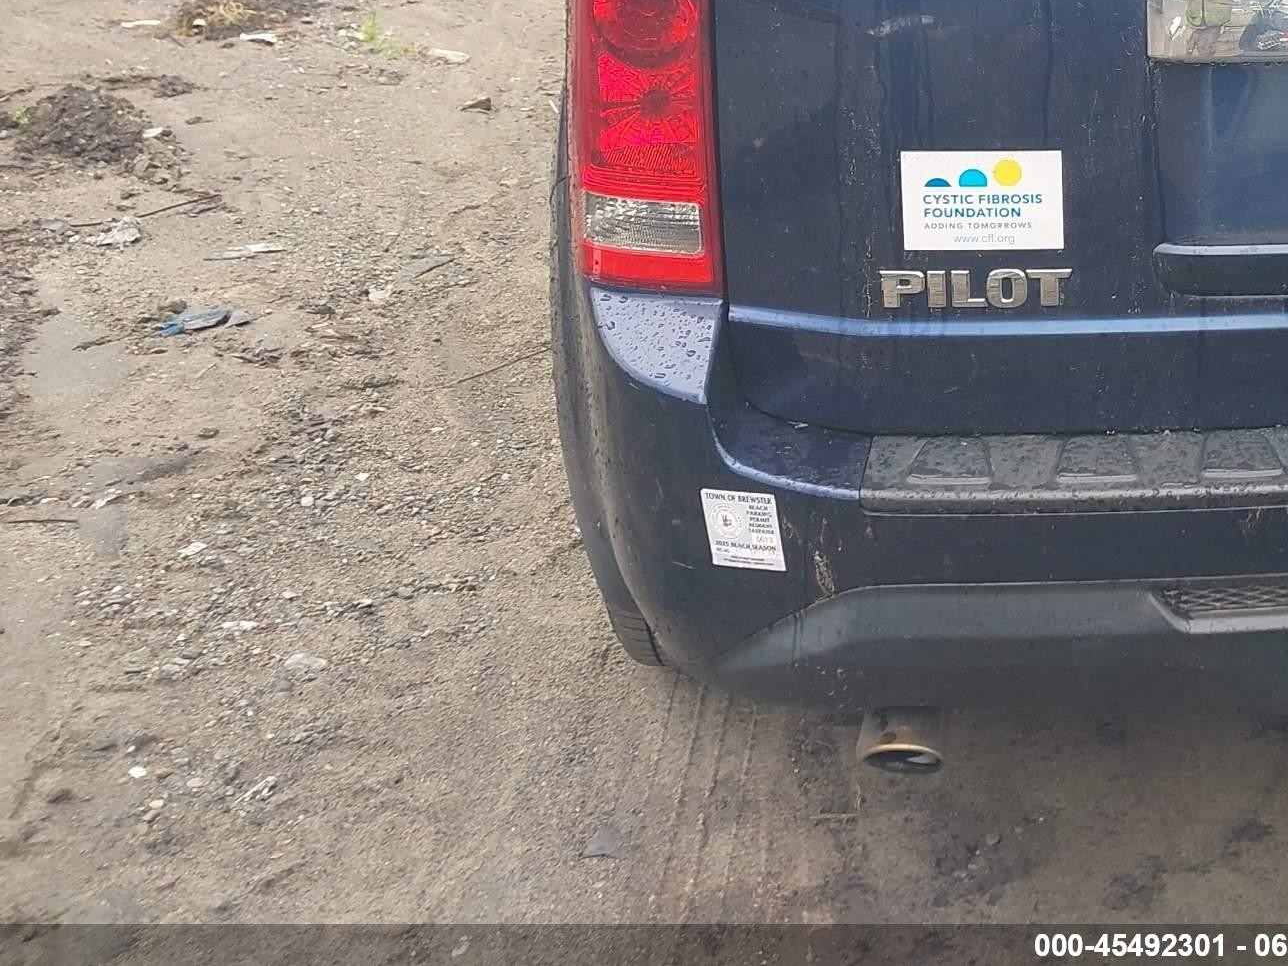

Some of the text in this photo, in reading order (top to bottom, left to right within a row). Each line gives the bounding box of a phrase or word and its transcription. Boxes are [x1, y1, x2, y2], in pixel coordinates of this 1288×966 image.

[923, 193, 1043, 205] CYSTIC FIBROSIS
[924, 207, 1021, 218] FOUNDATION
[924, 221, 1032, 230] ADDING TOMORROWS
[953, 234, 1016, 245] www.cff.org
[879, 268, 1073, 309] PILOT
[705, 492, 772, 504] TOWN OF BREWSTER
